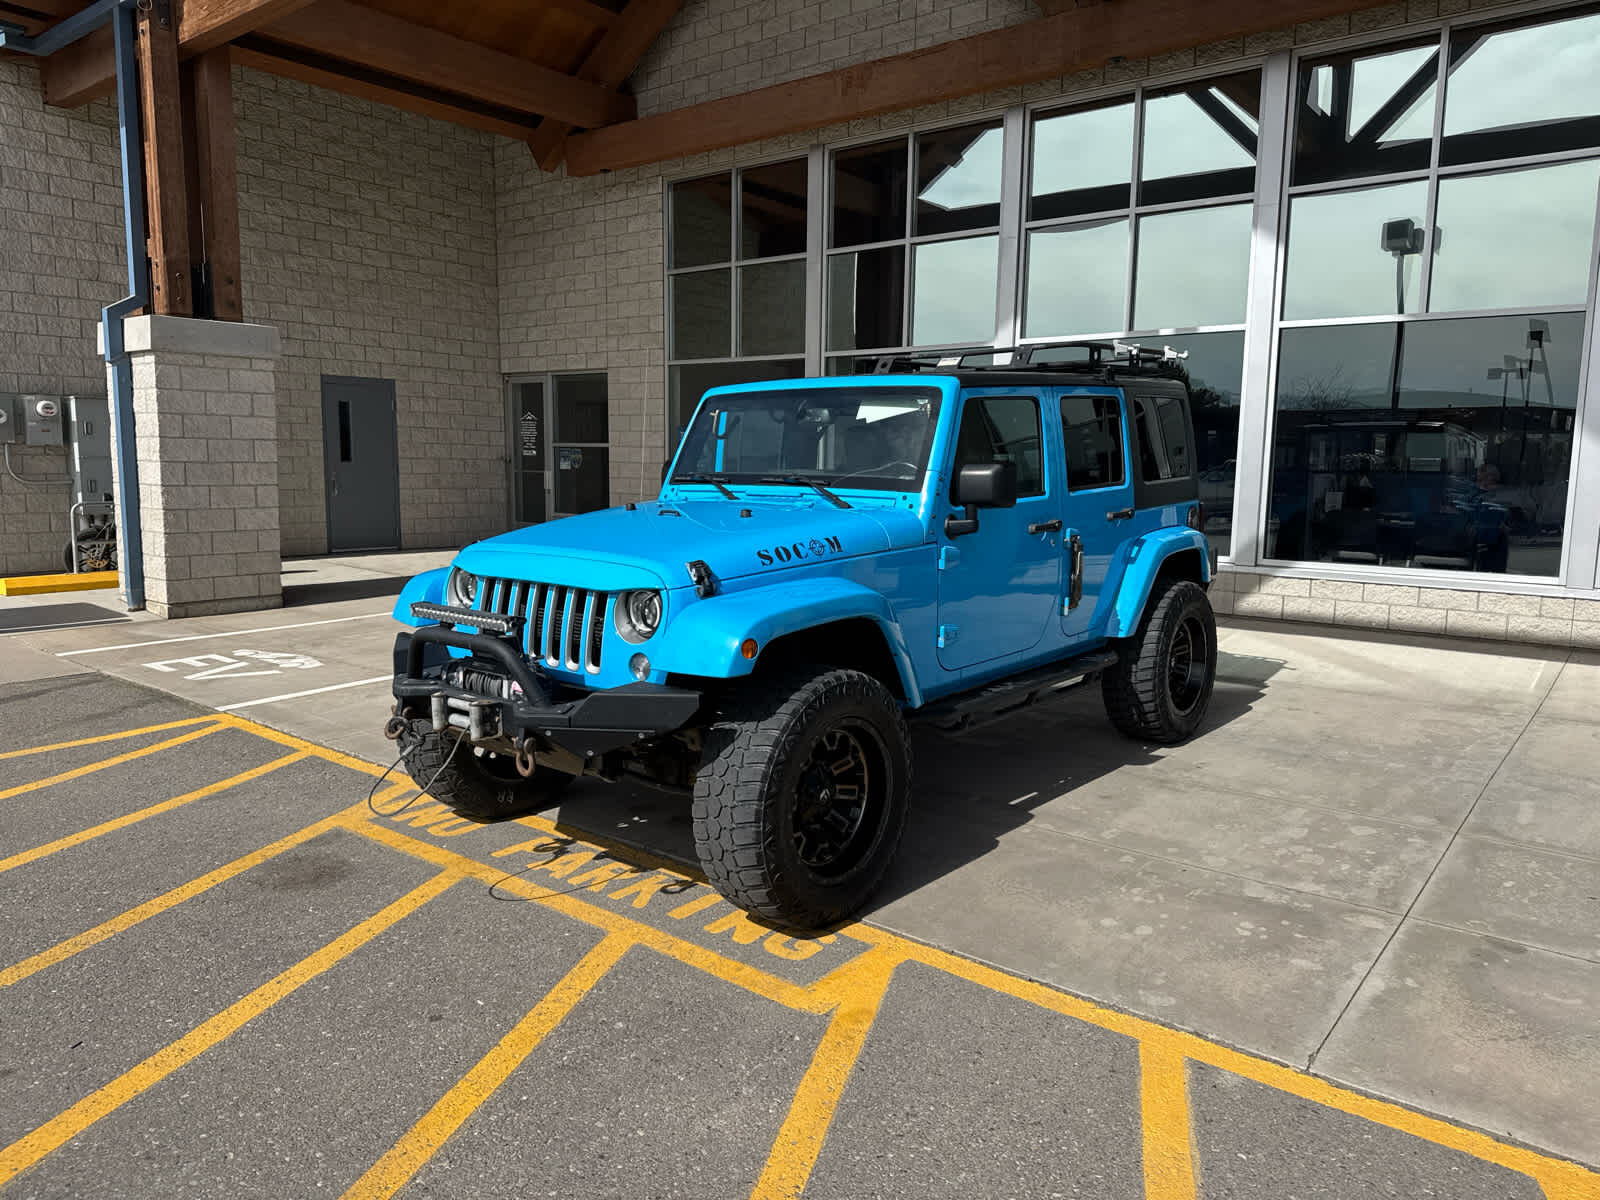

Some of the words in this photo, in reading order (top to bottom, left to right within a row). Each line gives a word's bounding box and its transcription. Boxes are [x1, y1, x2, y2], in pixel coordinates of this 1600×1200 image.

[141, 653, 284, 681] EV
[391, 802, 490, 837] NO
[490, 836, 838, 961] PARKING
